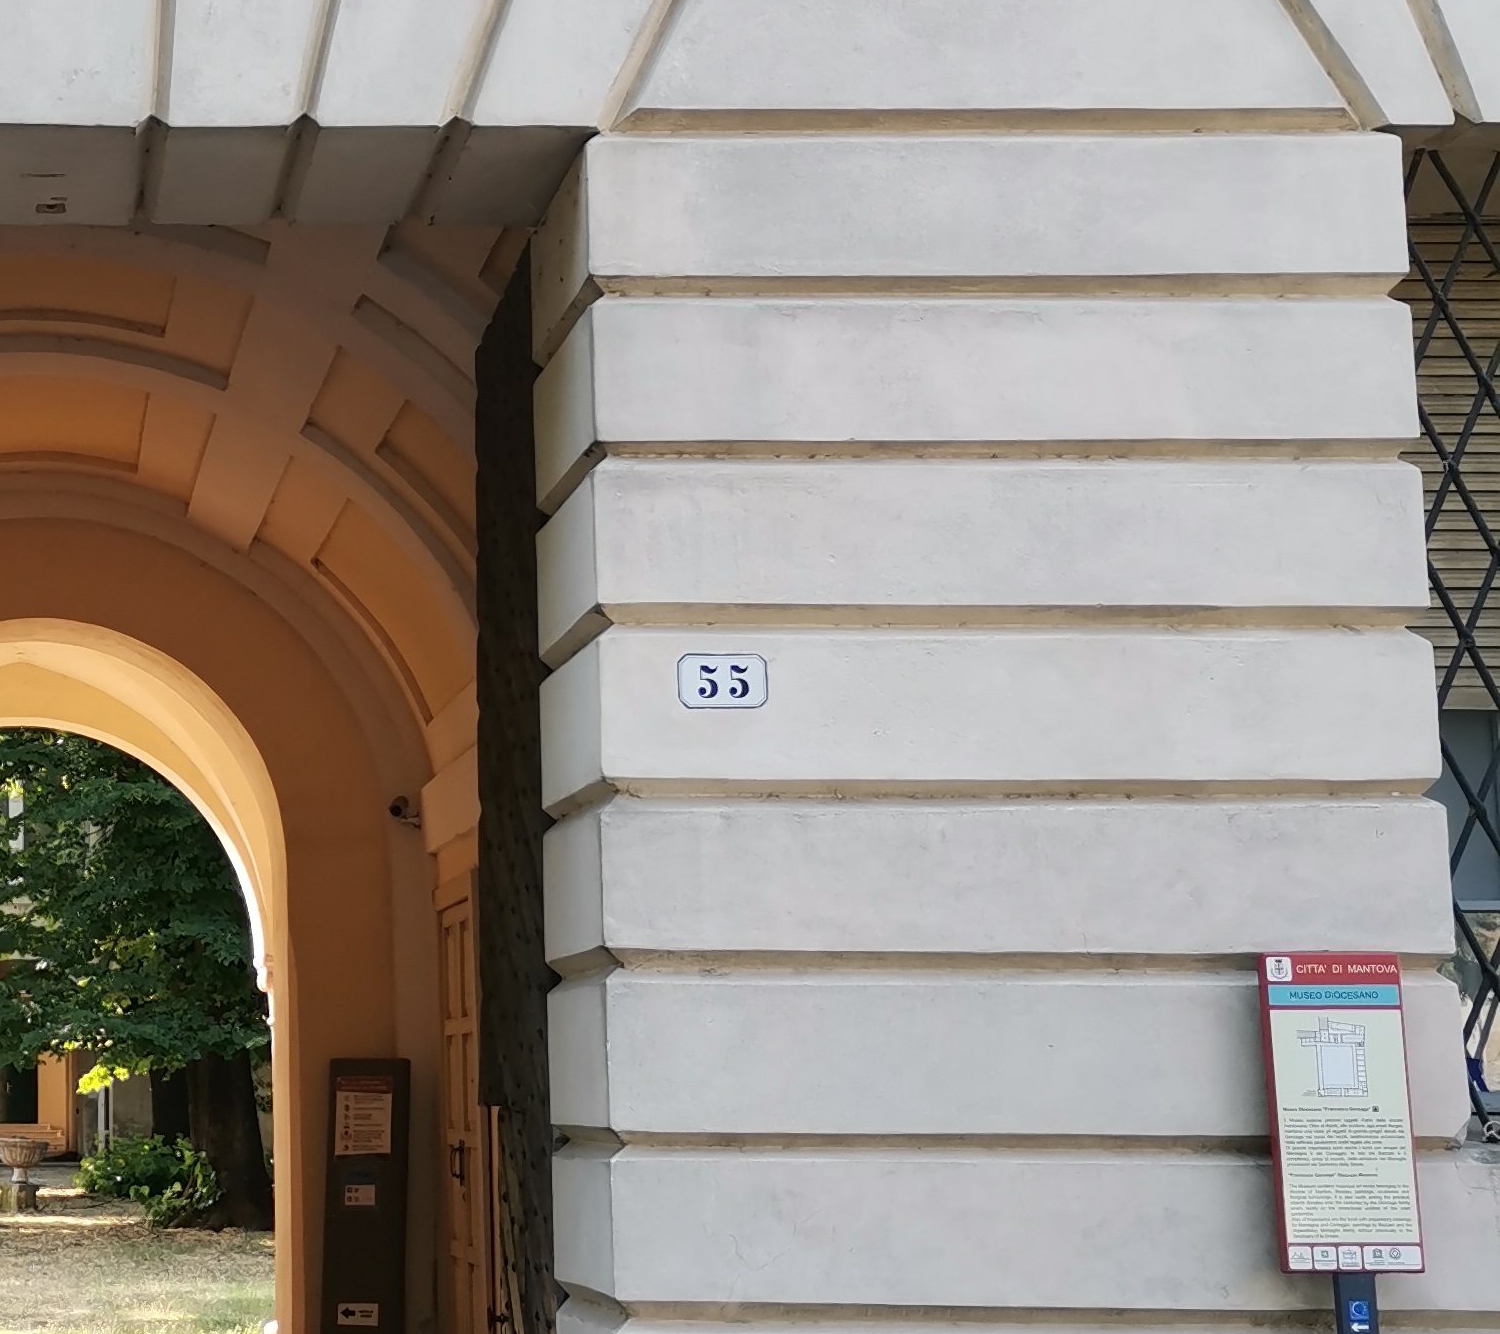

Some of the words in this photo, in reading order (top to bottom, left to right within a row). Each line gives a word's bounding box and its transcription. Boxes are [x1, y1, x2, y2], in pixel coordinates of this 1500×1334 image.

[698, 664, 750, 699] 55
[1295, 963, 1328, 974] CITTA'
[1331, 964, 1344, 974] DI
[1347, 964, 1398, 974] MANTOVA
[1289, 991, 1323, 1000] MUSEO
